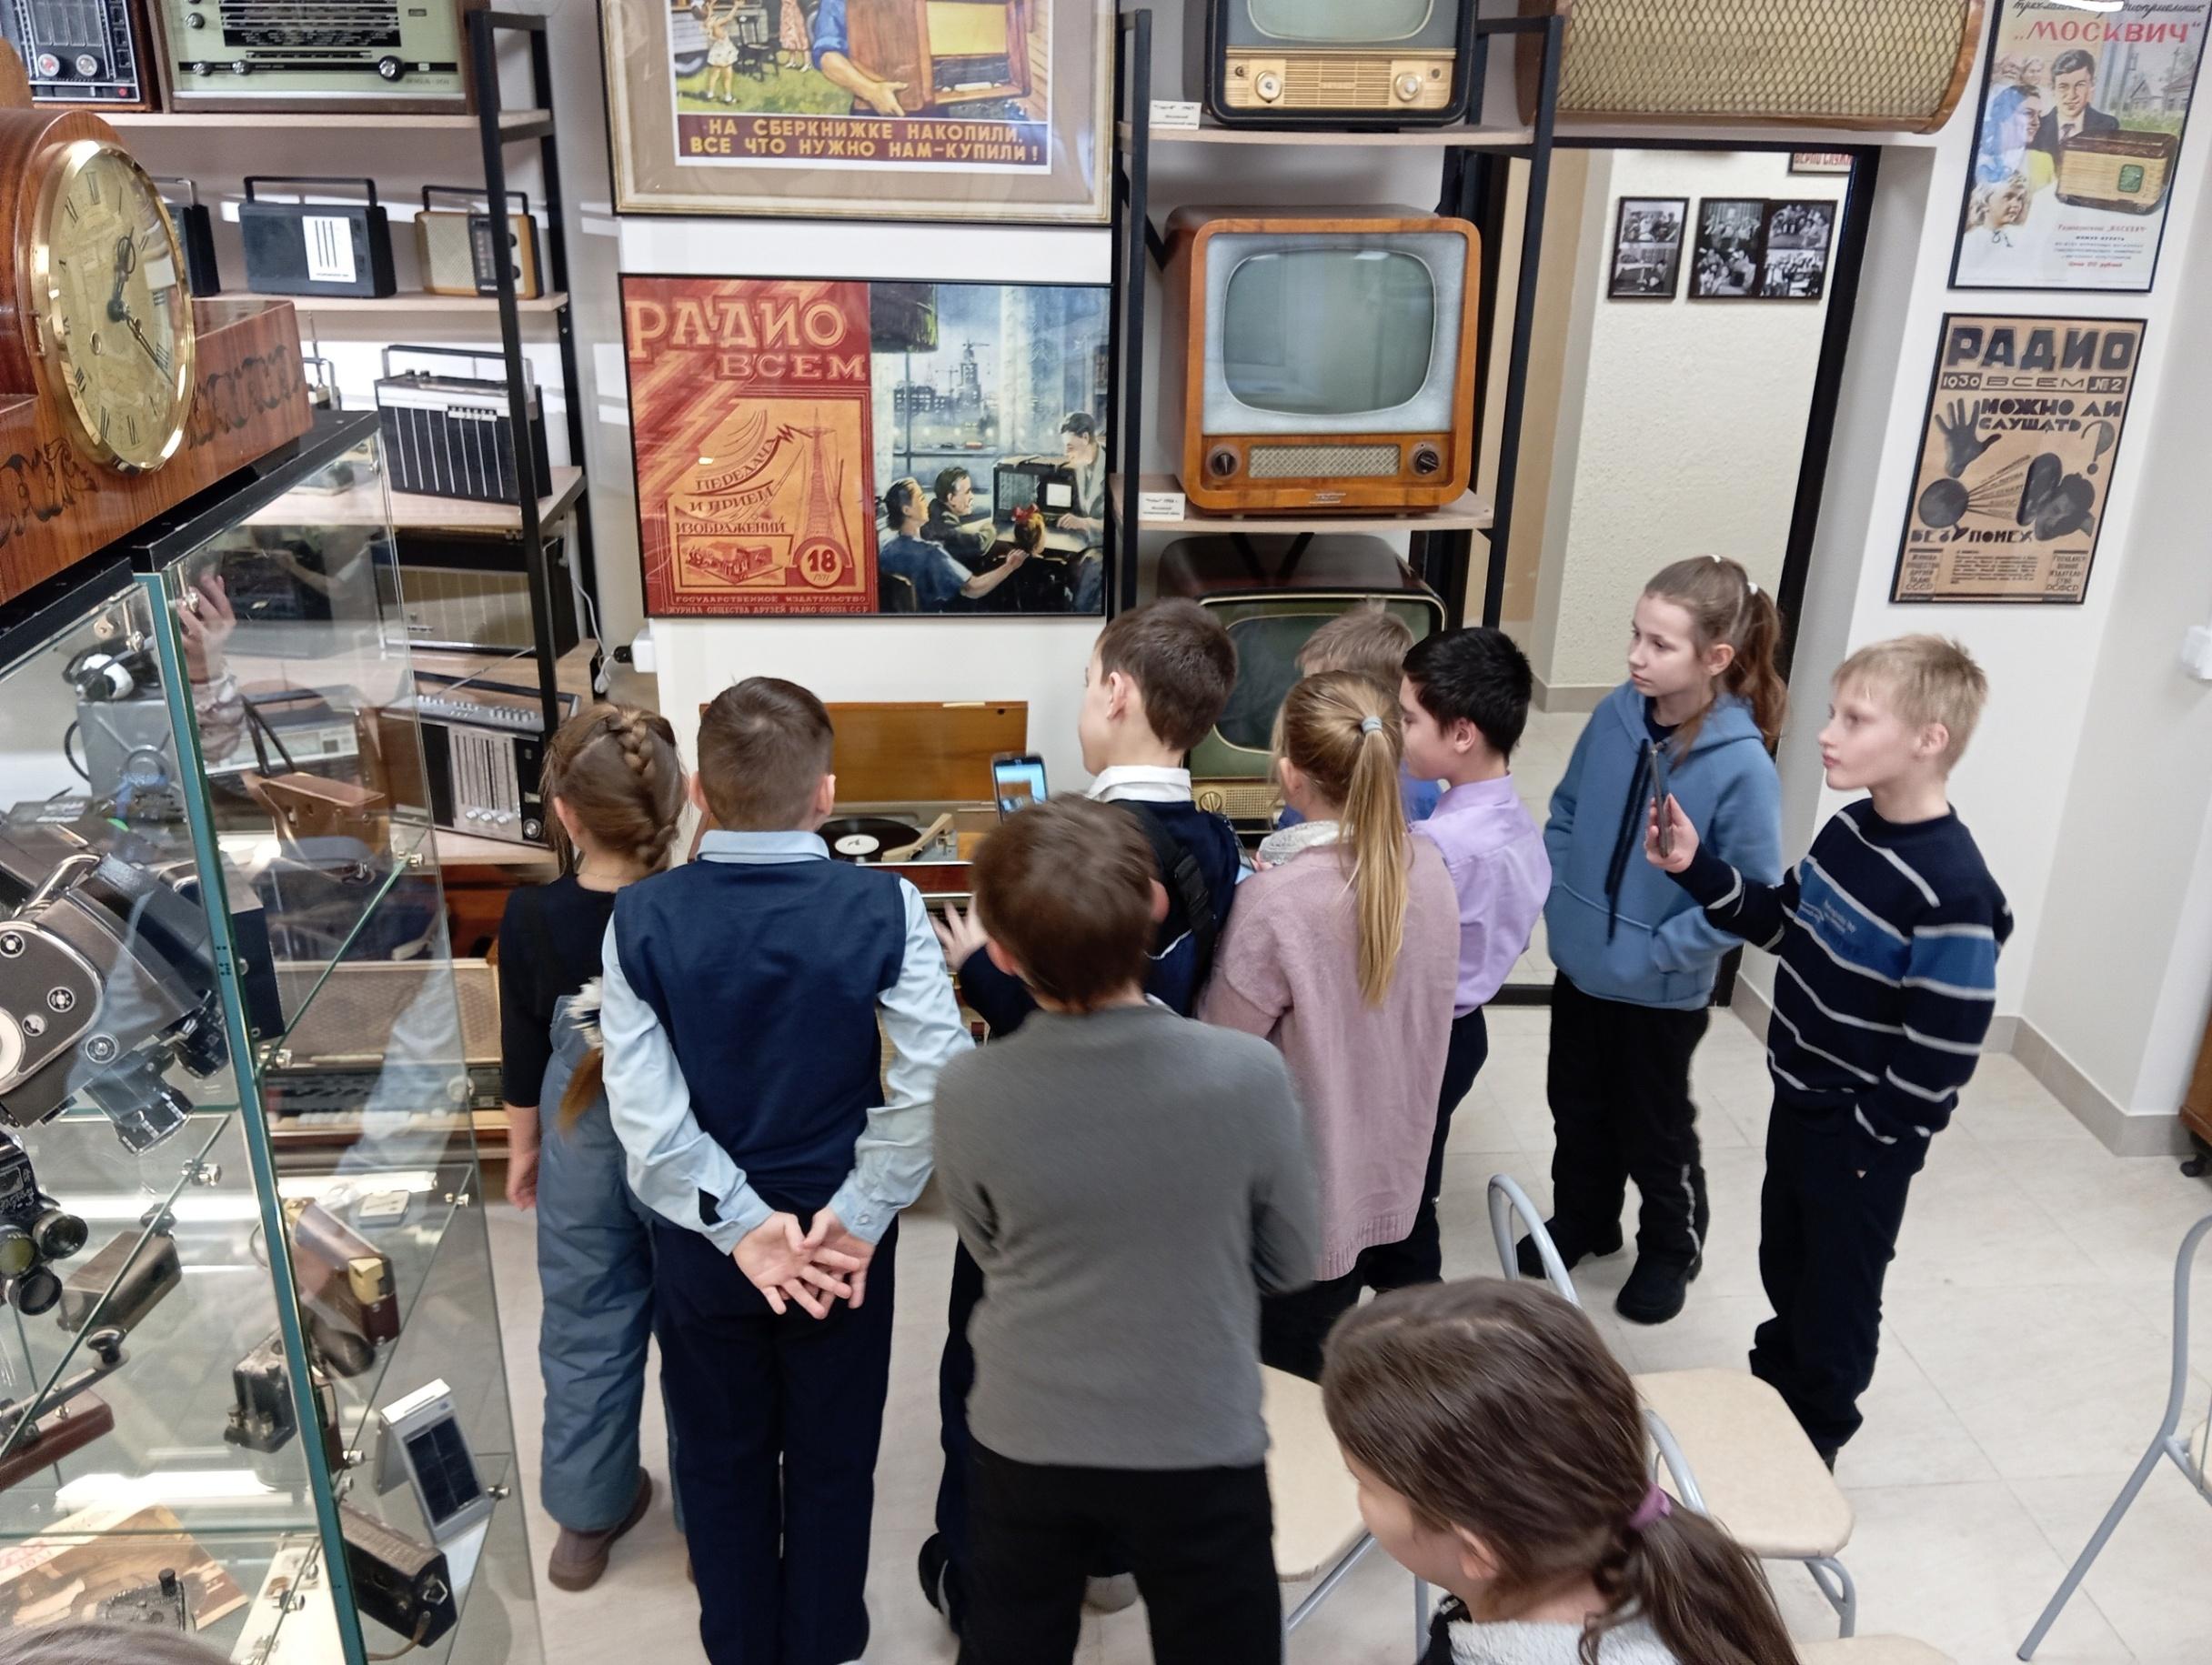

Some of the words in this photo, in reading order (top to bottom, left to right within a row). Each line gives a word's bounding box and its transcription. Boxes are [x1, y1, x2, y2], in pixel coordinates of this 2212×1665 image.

[709, 119, 738, 135] НА
[753, 119, 892, 139] СБЕРКНИЖКЕ
[690, 136, 731, 154] ВСЕ
[745, 137, 786, 154] ЧТО
[799, 138, 875, 156] НУЖНО
[626, 299, 846, 359] РАДИО
[1945, 326, 2137, 372] РАДИО
[717, 351, 866, 383] ВСЕМ
[1943, 374, 1980, 388] 1930
[1986, 376, 2084, 388] ВСЕМ
[1980, 398, 2075, 416] МОЖНО
[2081, 400, 2123, 417] ЛИ
[1978, 417, 2082, 434] СЛУШАТЬ
[690, 501, 704, 511] И
[676, 518, 786, 533] ИЗОБРАЖЕНИЙ
[1968, 529, 2034, 543] ПОМЕХ
[807, 549, 837, 573] 18
[676, 596, 778, 604] ГОСУДАРСТВЕННОЕ
[789, 606, 817, 614] РАДИО
